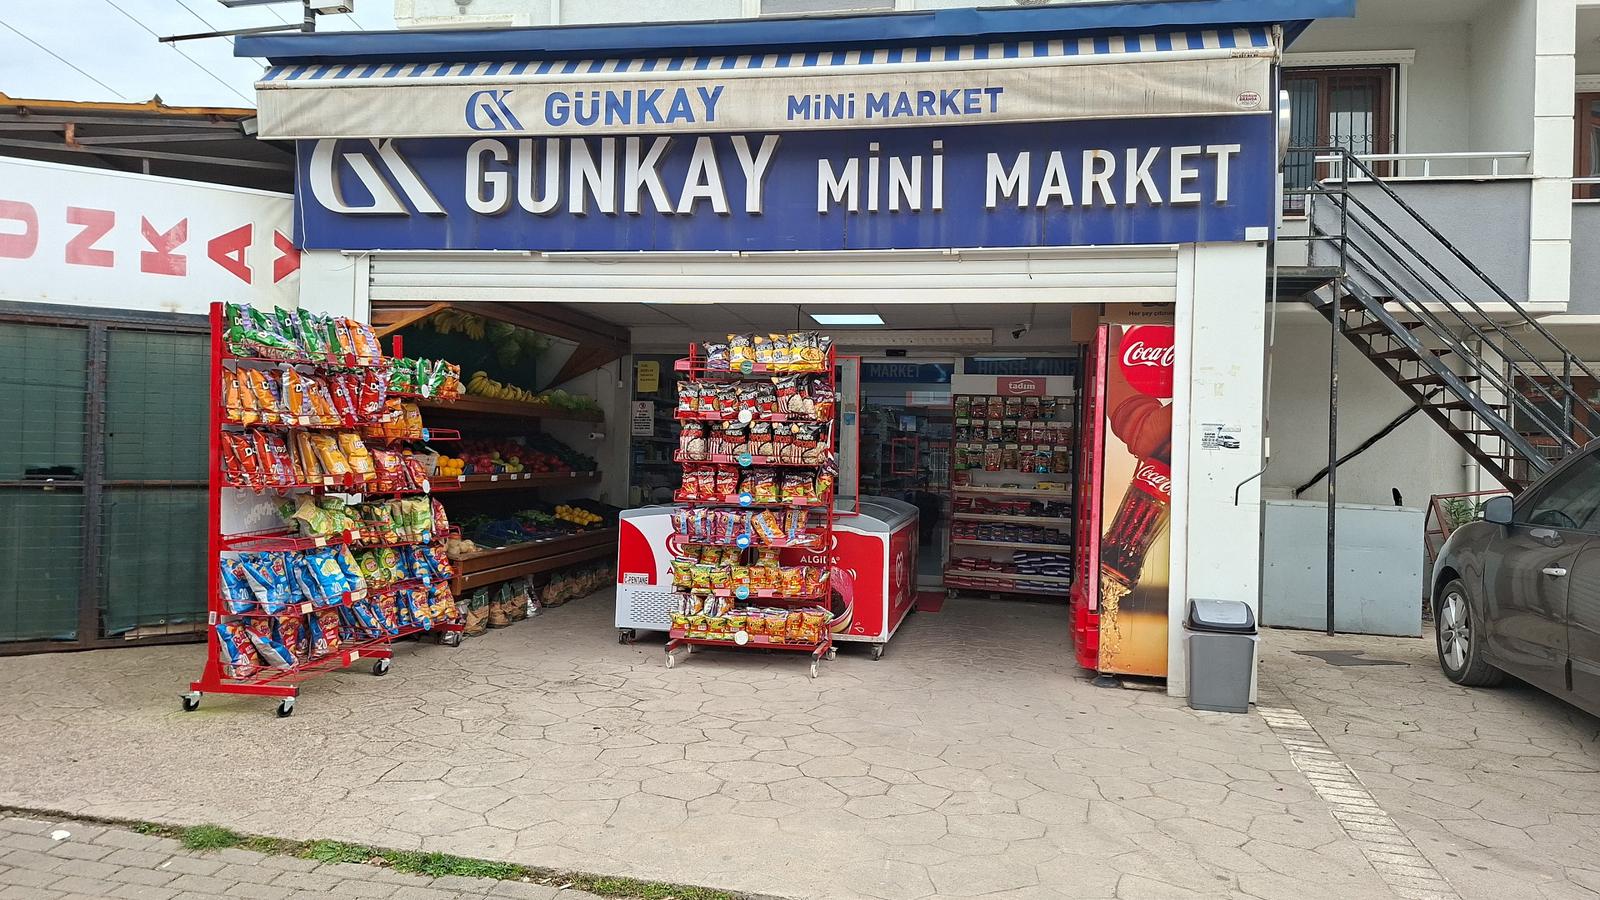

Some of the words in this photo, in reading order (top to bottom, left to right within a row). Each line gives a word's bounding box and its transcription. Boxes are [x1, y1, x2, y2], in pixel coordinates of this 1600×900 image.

[545, 86, 724, 126] GÜNKAY
[865, 87, 1004, 119] MARKET
[985, 144, 1241, 209] MARKET
